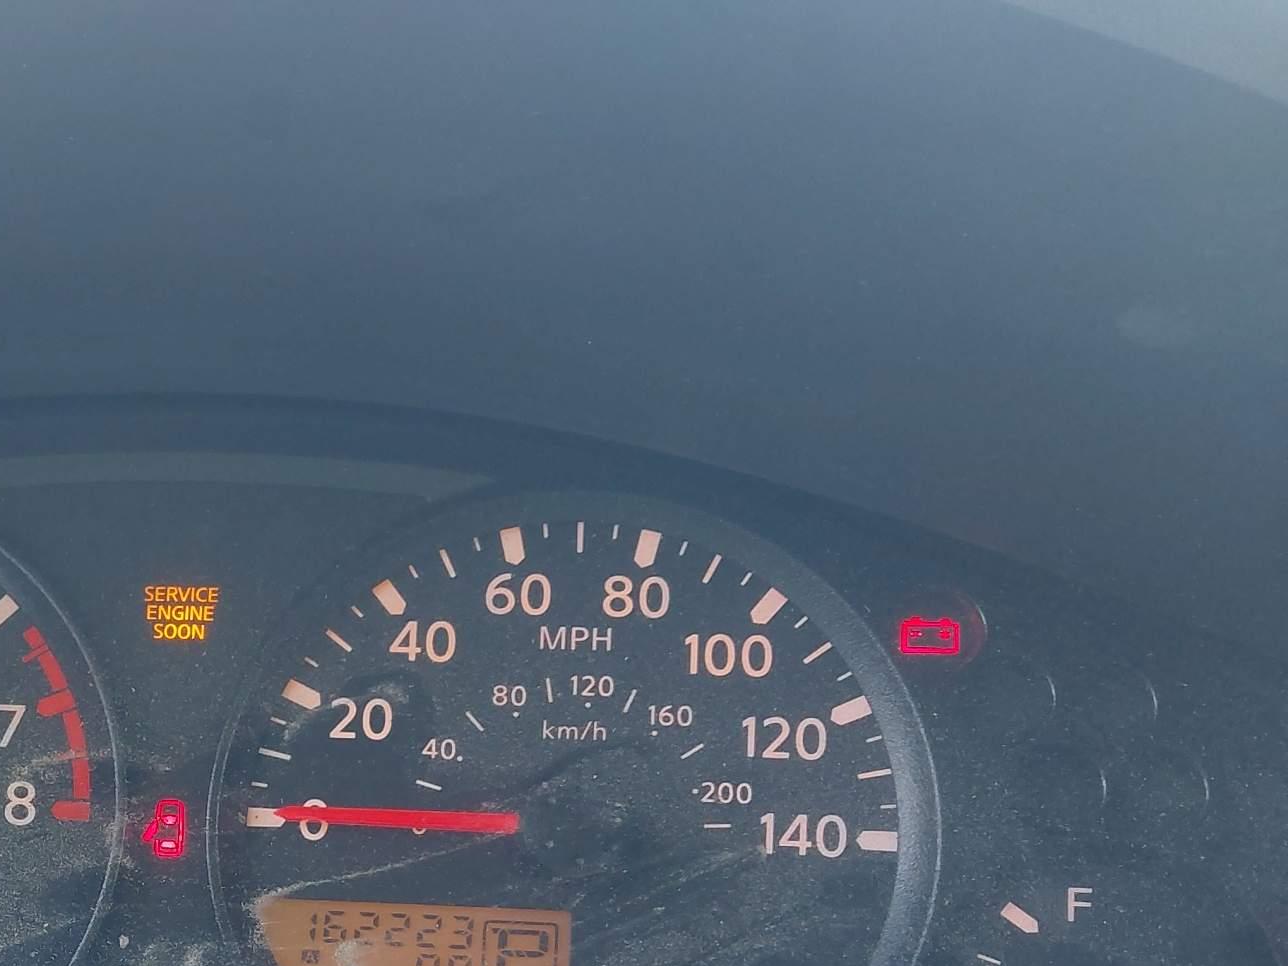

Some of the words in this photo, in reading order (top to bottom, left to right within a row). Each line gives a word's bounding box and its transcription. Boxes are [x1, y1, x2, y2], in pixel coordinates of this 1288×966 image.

[144, 585, 219, 603] SERVICE
[485, 573, 552, 616] 60
[602, 575, 670, 619] 80
[146, 604, 214, 621] ENGINE
[153, 623, 205, 640] SOON
[389, 620, 456, 663] 40
[539, 625, 612, 651] MPH
[684, 633, 773, 678] 100
[492, 685, 527, 707] 80
[570, 675, 614, 697] 120
[329, 697, 393, 741] 20
[542, 719, 607, 741] km/h
[648, 705, 693, 727] 160
[421, 738, 456, 760] 40
[742, 716, 827, 761] 120
[4, 781, 36, 826] 8
[700, 782, 753, 804] 200
[760, 812, 847, 858] 140
[1067, 887, 1093, 922] F
[308, 910, 474, 949] 162223
